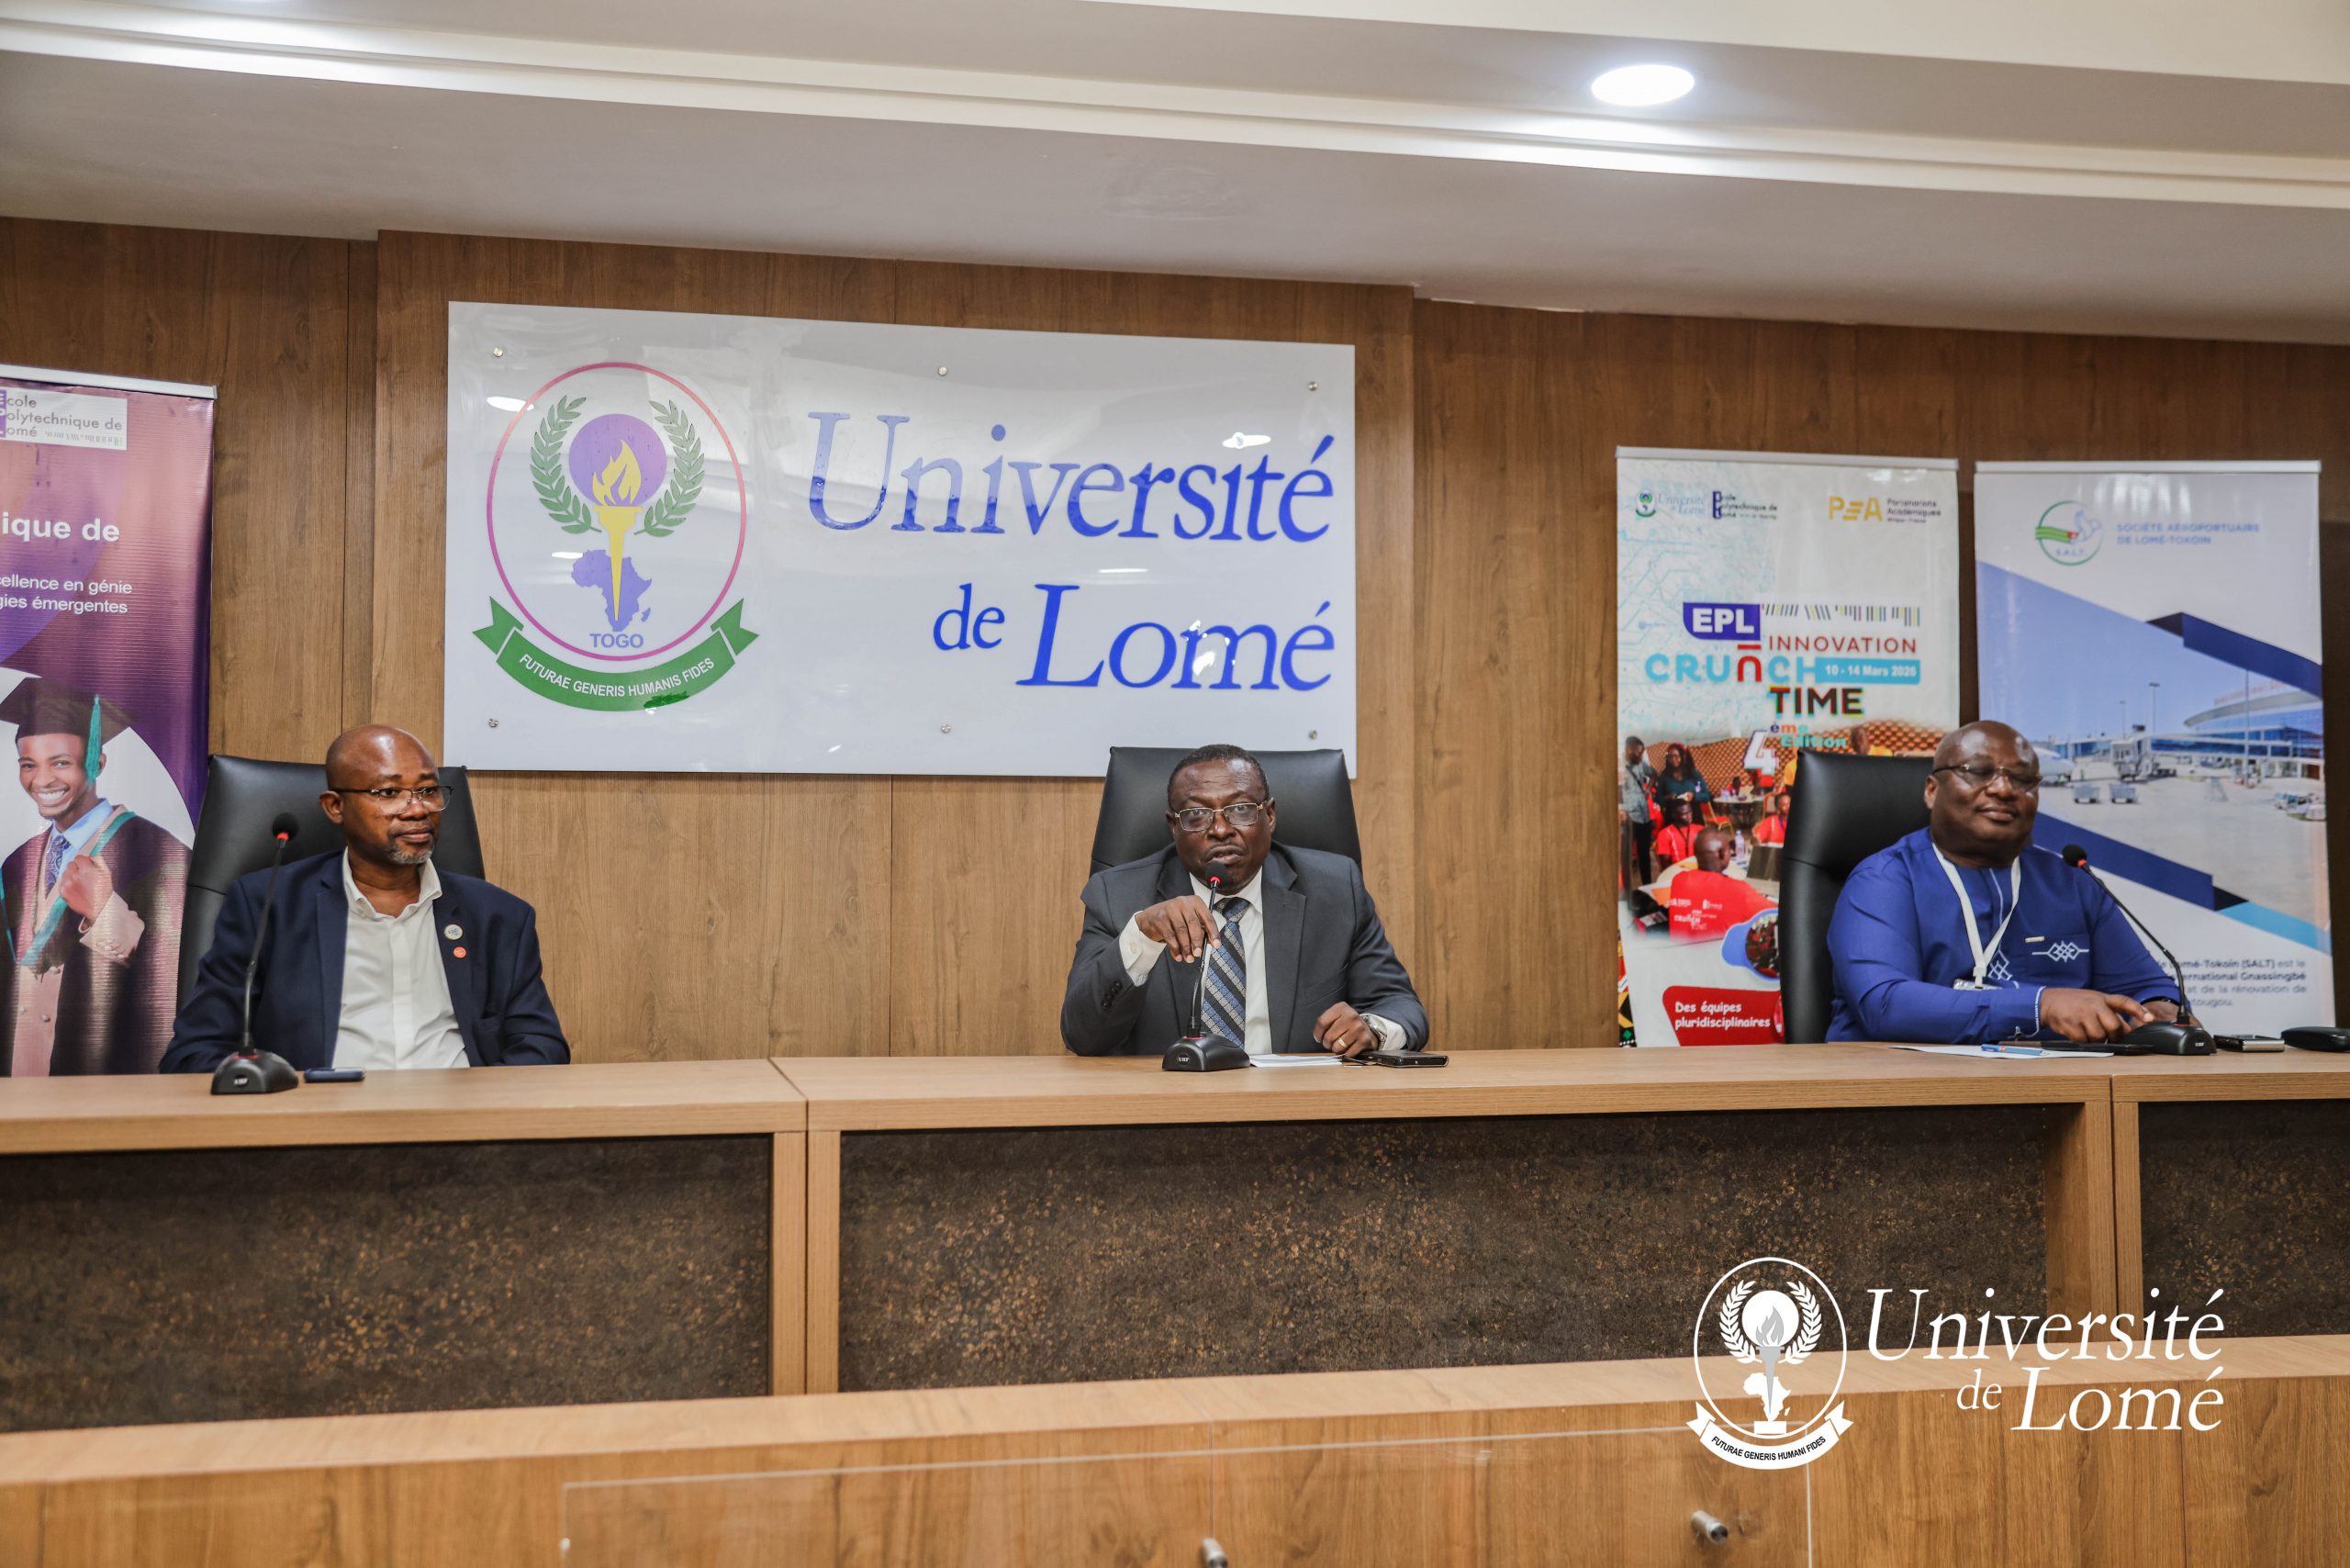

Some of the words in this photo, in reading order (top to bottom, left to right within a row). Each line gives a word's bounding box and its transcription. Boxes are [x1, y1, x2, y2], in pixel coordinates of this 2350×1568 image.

[105, 418, 122, 431] de
[807, 411, 1335, 543] Université
[83, 518, 120, 542] de
[63, 580, 84, 591] en
[88, 579, 132, 595] génie
[32, 597, 128, 614] émergentes
[1692, 608, 1754, 633] EPL
[589, 633, 643, 648] TOGO
[933, 583, 1005, 651] de
[1015, 584, 1335, 691] Lomé
[1769, 635, 1917, 655] INNOVATION
[519, 654, 572, 689] FUTURAE
[573, 680, 625, 698] GENERIS
[628, 675, 681, 697] HUMANIS
[682, 657, 715, 682] FIDES
[1825, 665, 1839, 676] 10
[1848, 665, 1860, 677] 14
[1863, 666, 1888, 678] Mars
[1769, 686, 1864, 717] TIME
[2181, 971, 2238, 980] ernational
[1674, 1002, 1696, 1014] Des
[1701, 1001, 1742, 1014] équipes
[1674, 1016, 1771, 1030] pluridisciplinaires
